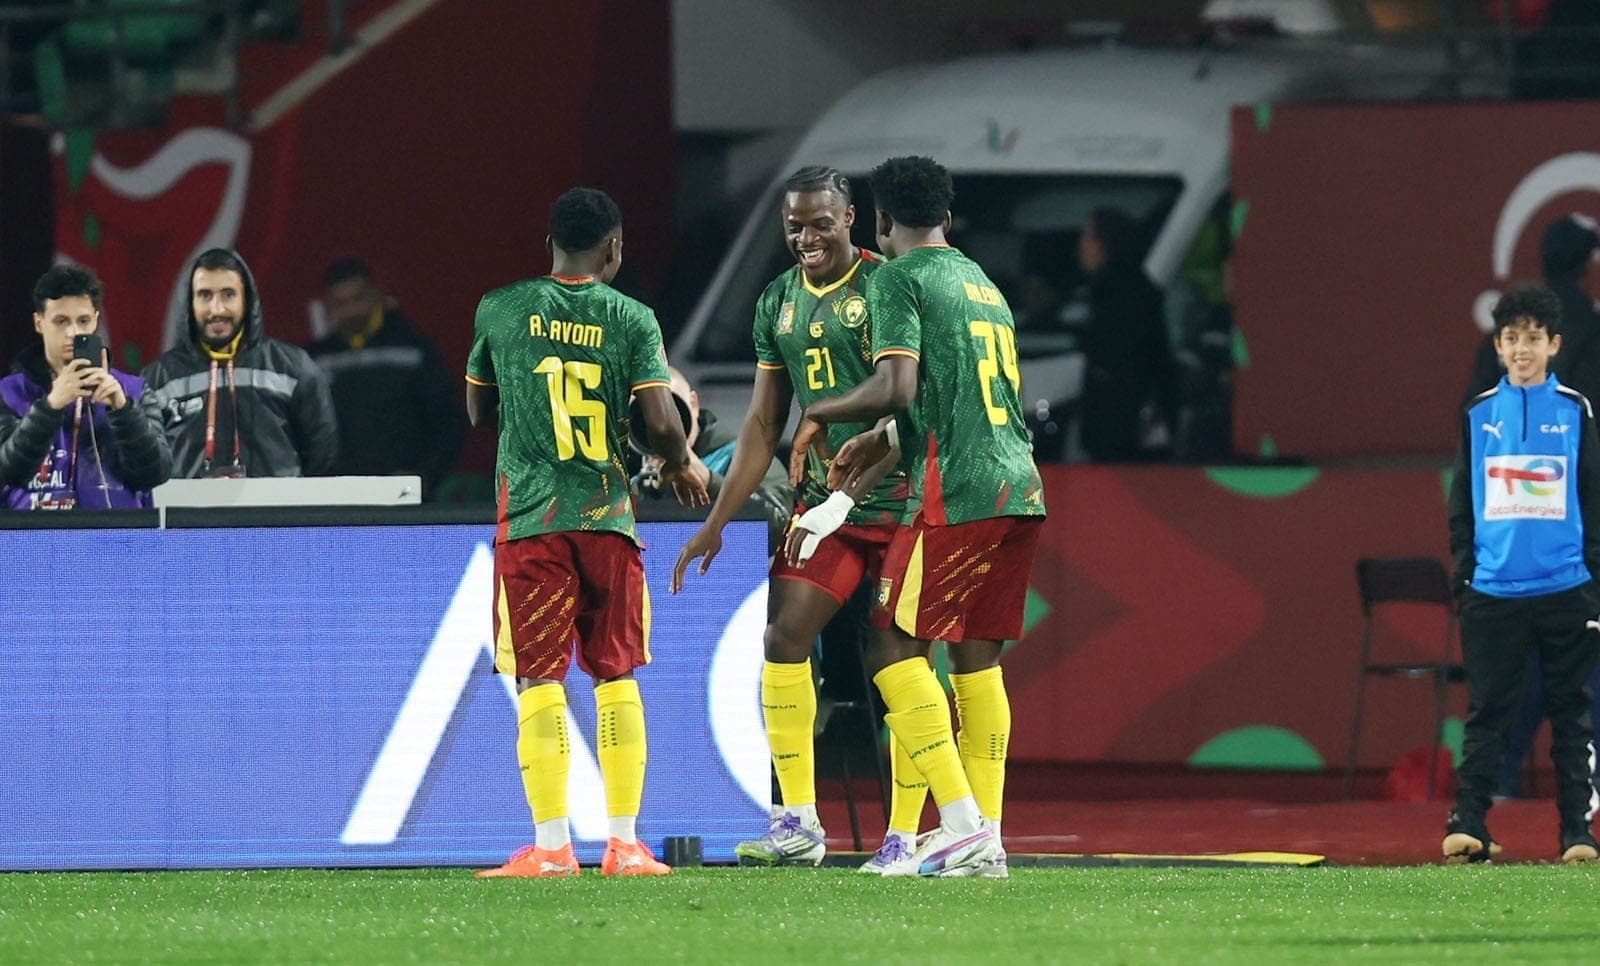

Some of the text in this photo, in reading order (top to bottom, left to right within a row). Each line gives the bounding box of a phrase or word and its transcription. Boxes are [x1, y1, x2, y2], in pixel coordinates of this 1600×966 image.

[550, 320, 604, 348] AVOM
[805, 347, 836, 390] 21
[970, 320, 1020, 426] 24
[532, 356, 609, 461] 15
[1540, 423, 1571, 434] CAF
